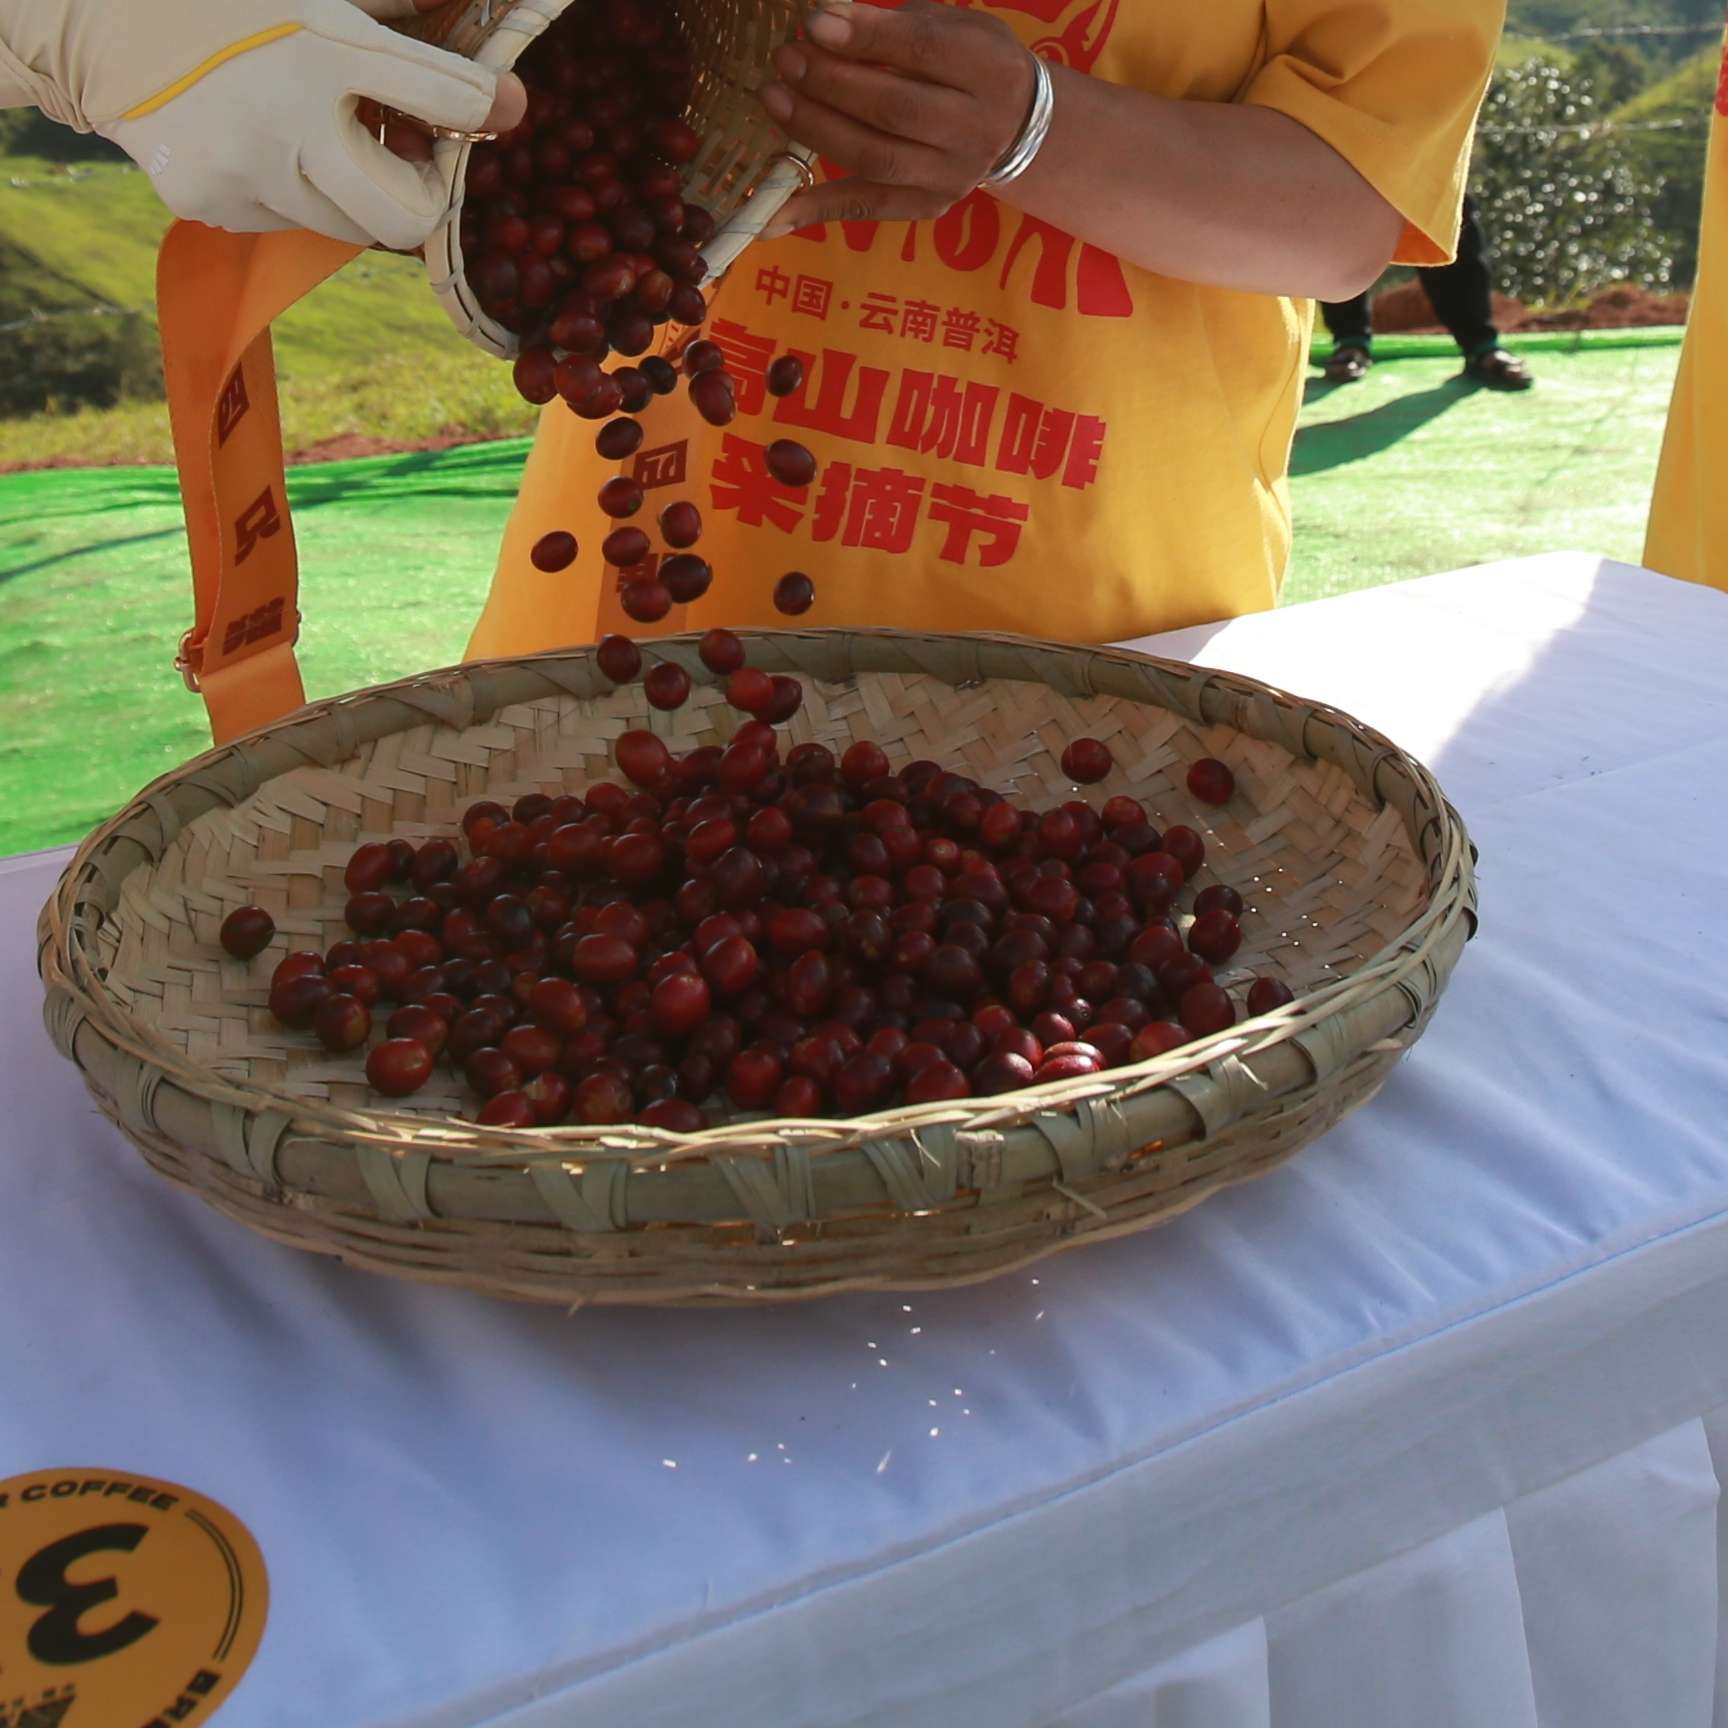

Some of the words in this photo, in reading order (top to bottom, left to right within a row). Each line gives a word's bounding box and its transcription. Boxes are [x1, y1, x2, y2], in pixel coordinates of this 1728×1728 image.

[709, 317, 1107, 491] 高山咖啡
[709, 432, 1030, 568] 采摘节
[20, 1479, 180, 1512] COFFEE
